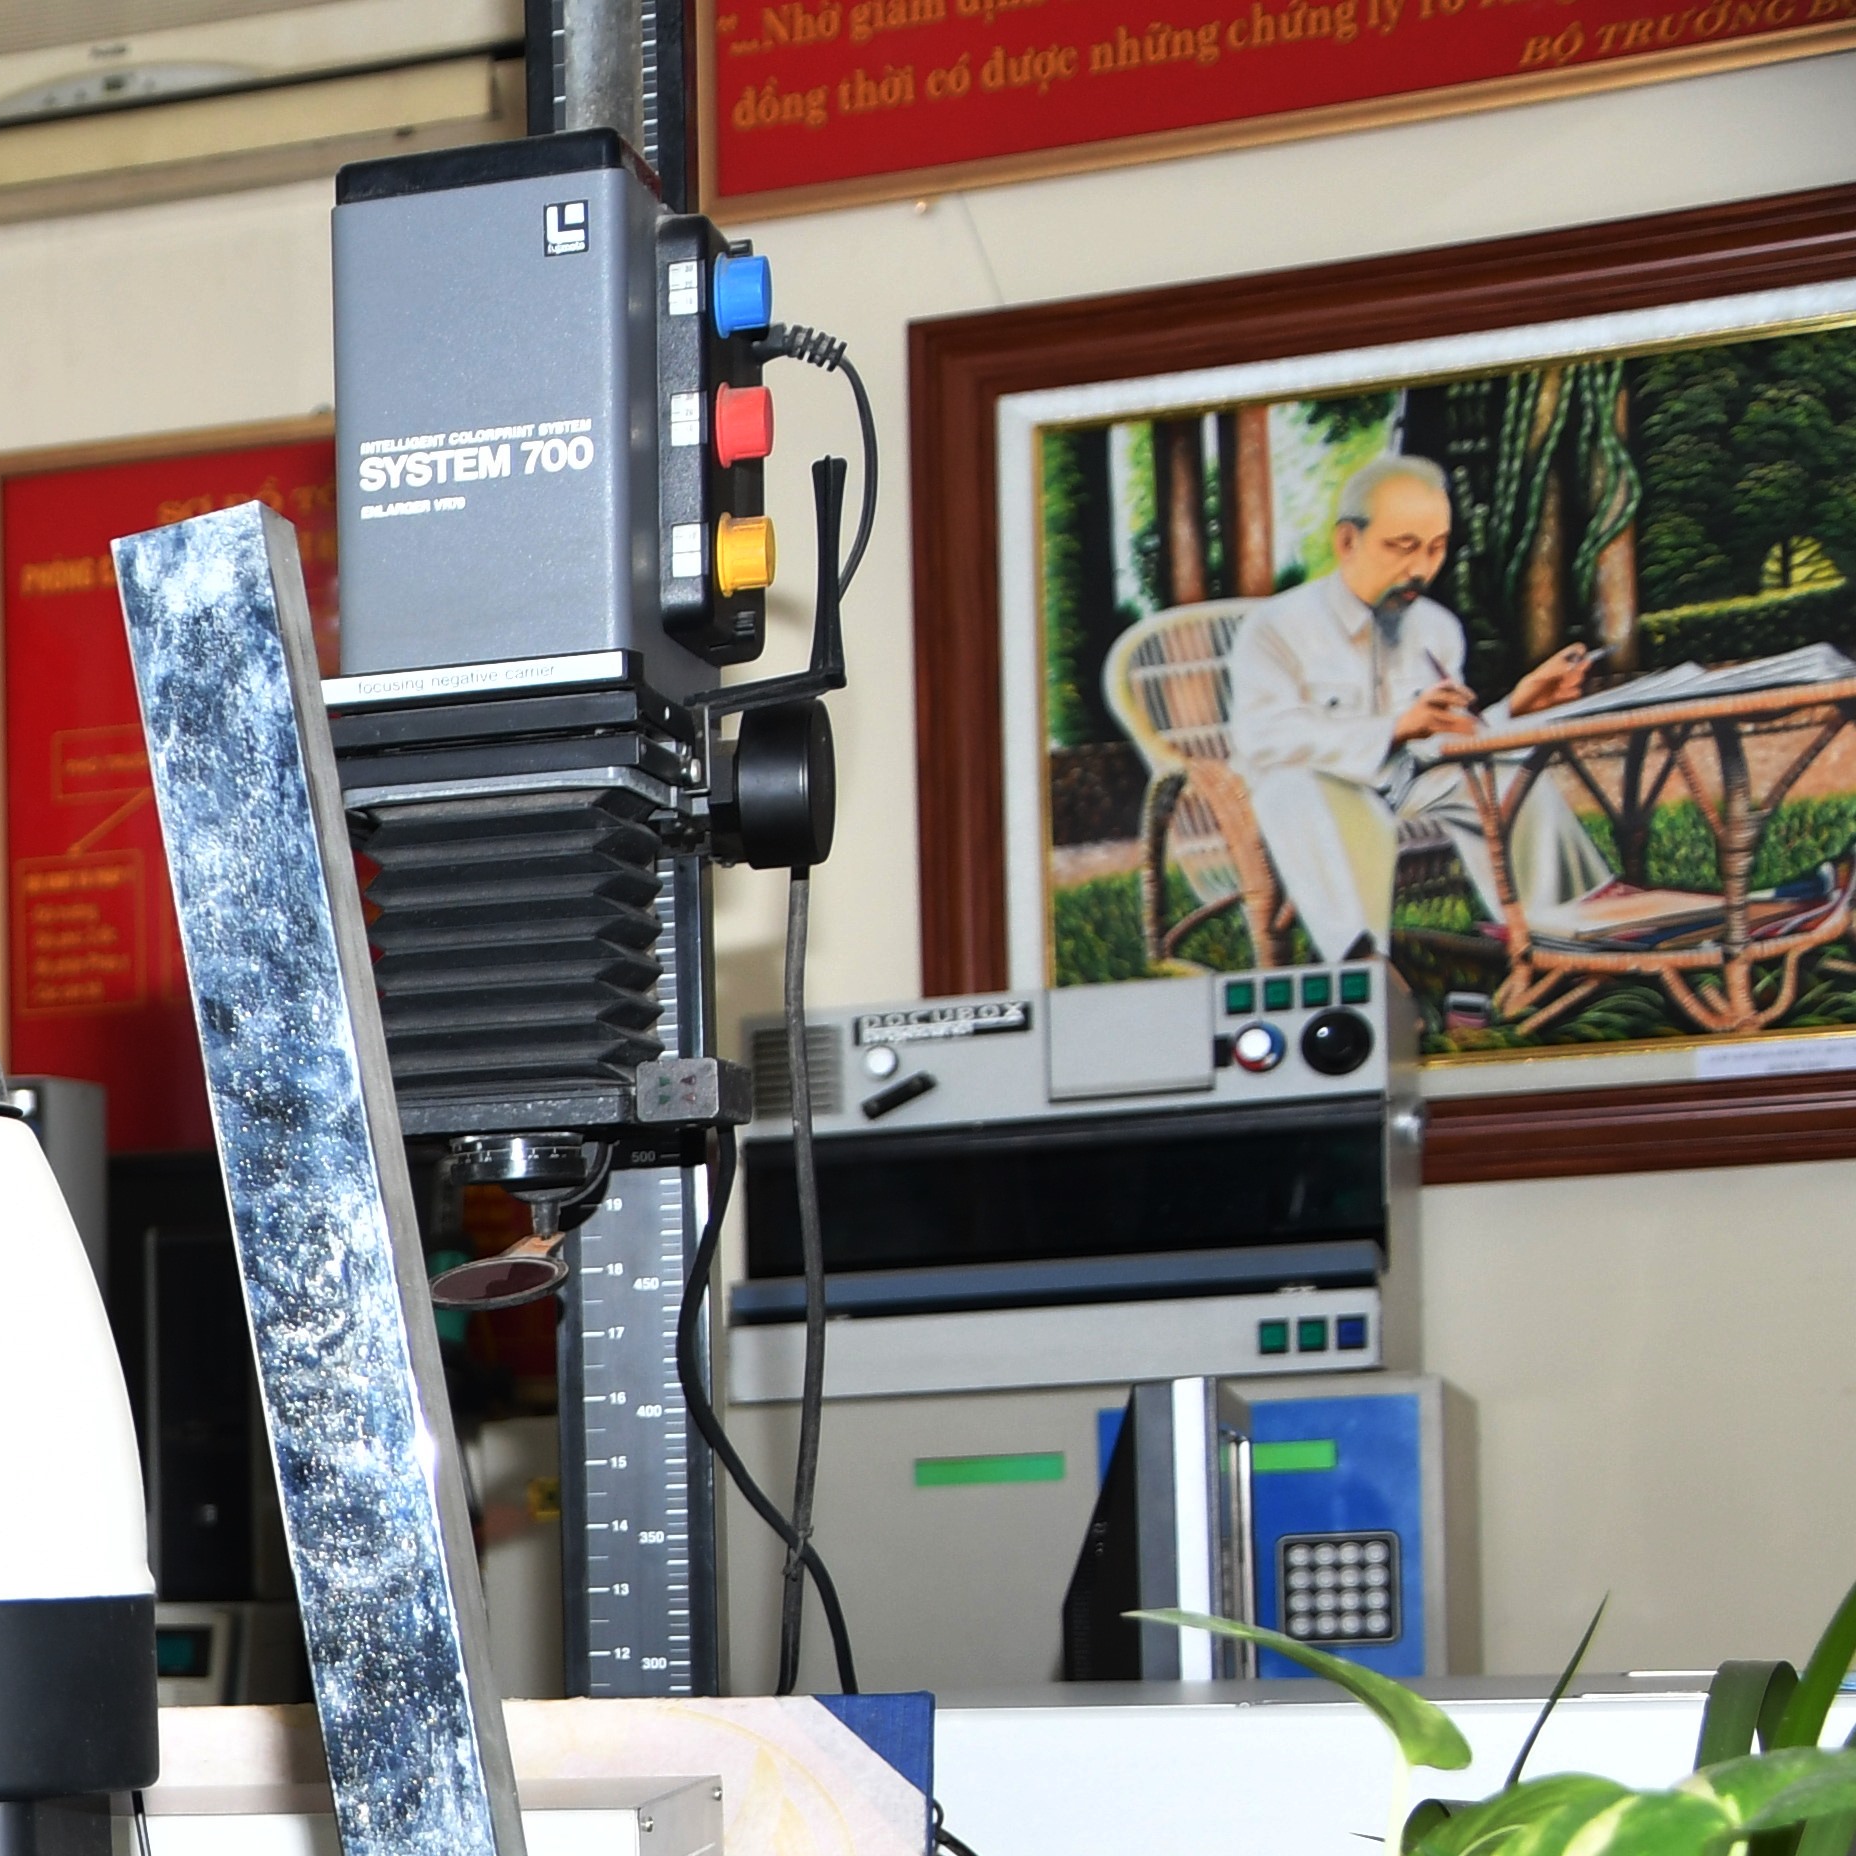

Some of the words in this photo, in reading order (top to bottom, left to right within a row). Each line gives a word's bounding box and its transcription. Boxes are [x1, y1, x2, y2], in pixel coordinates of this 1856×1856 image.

[1518, 20, 1586, 68] BỘ
[731, 76, 830, 129] đồng
[837, 64, 916, 113] thời
[924, 51, 974, 98] có
[981, 41, 1080, 94] được
[1088, 20, 1224, 73] những
[360, 433, 447, 456] INTELLIGENT
[538, 418, 592, 437] SYSTEM
[359, 443, 511, 492] SYSTEM
[520, 435, 594, 475] 700
[358, 680, 424, 696] focusing
[431, 669, 498, 688] negative
[505, 664, 555, 679] carrier
[631, 1150, 656, 1163] 500
[605, 1199, 623, 1211] 19
[606, 1263, 624, 1276] 18
[633, 1277, 660, 1290] 450
[607, 1327, 625, 1340] 17
[608, 1391, 626, 1405] 16
[636, 1405, 662, 1418] 400
[610, 1456, 627, 1469] 15
[611, 1520, 628, 1533] 14
[638, 1531, 665, 1544] 350
[612, 1583, 629, 1596] 13
[613, 1647, 630, 1660] 12
[641, 1657, 667, 1670] 300
